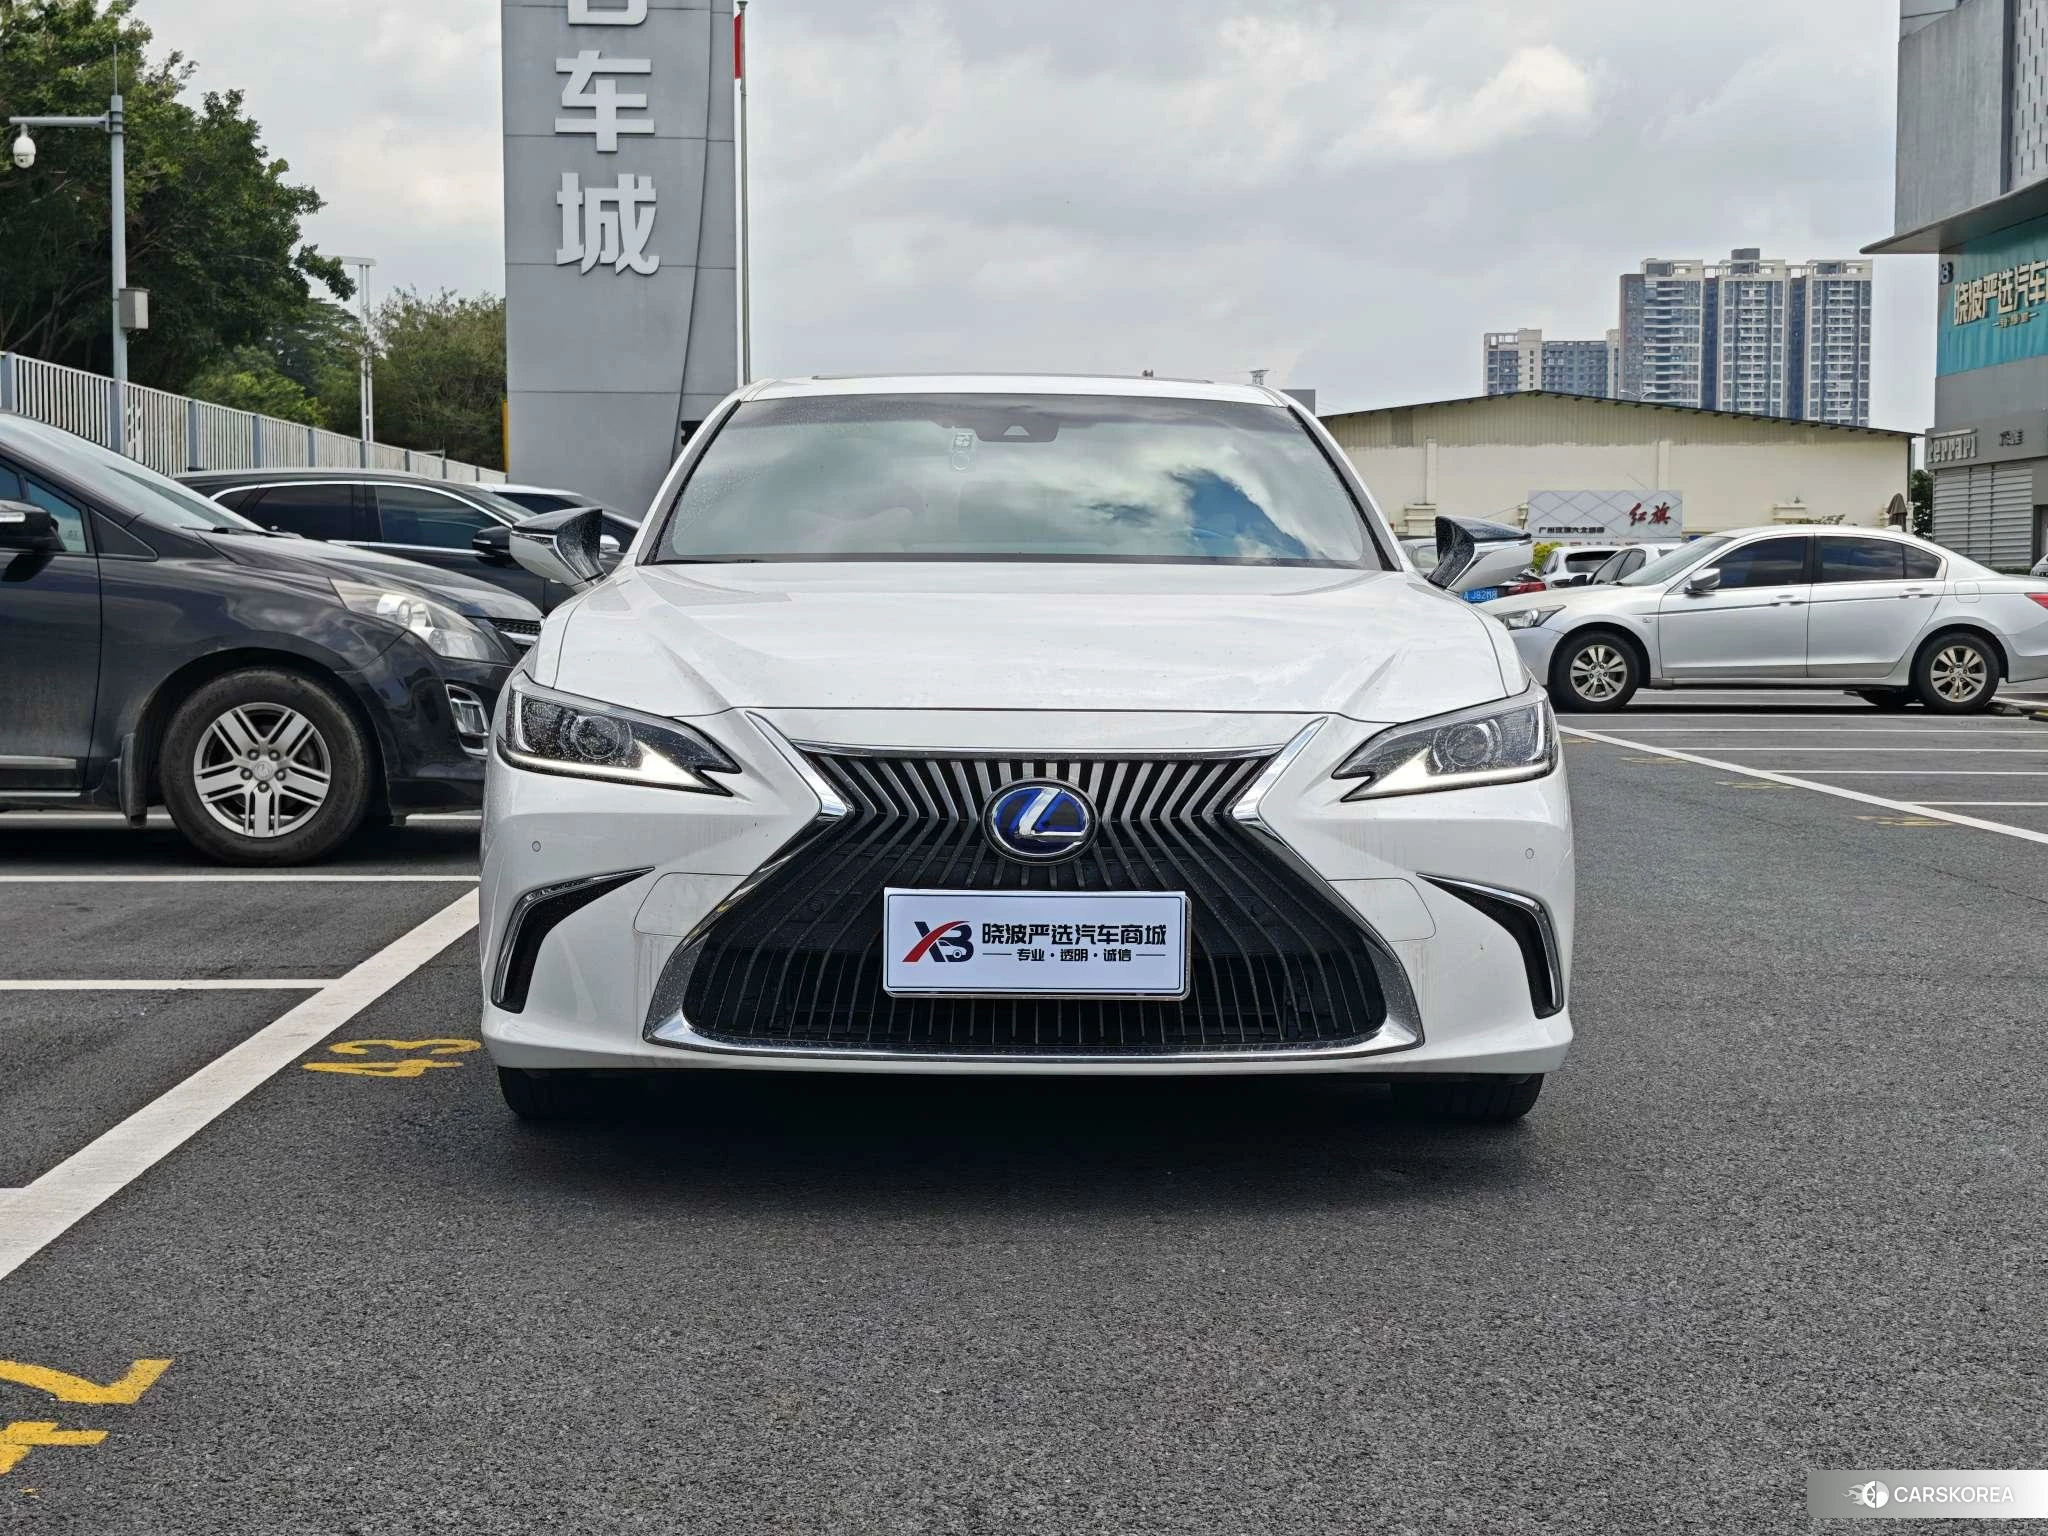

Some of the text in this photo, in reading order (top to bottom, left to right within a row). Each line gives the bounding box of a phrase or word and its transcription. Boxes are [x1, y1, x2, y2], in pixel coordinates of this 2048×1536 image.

[1953, 255, 2048, 325] 晓波严选汽车
[1628, 501, 1672, 526] 红旗
[982, 923, 1166, 945] 晓波严选汽车商城
